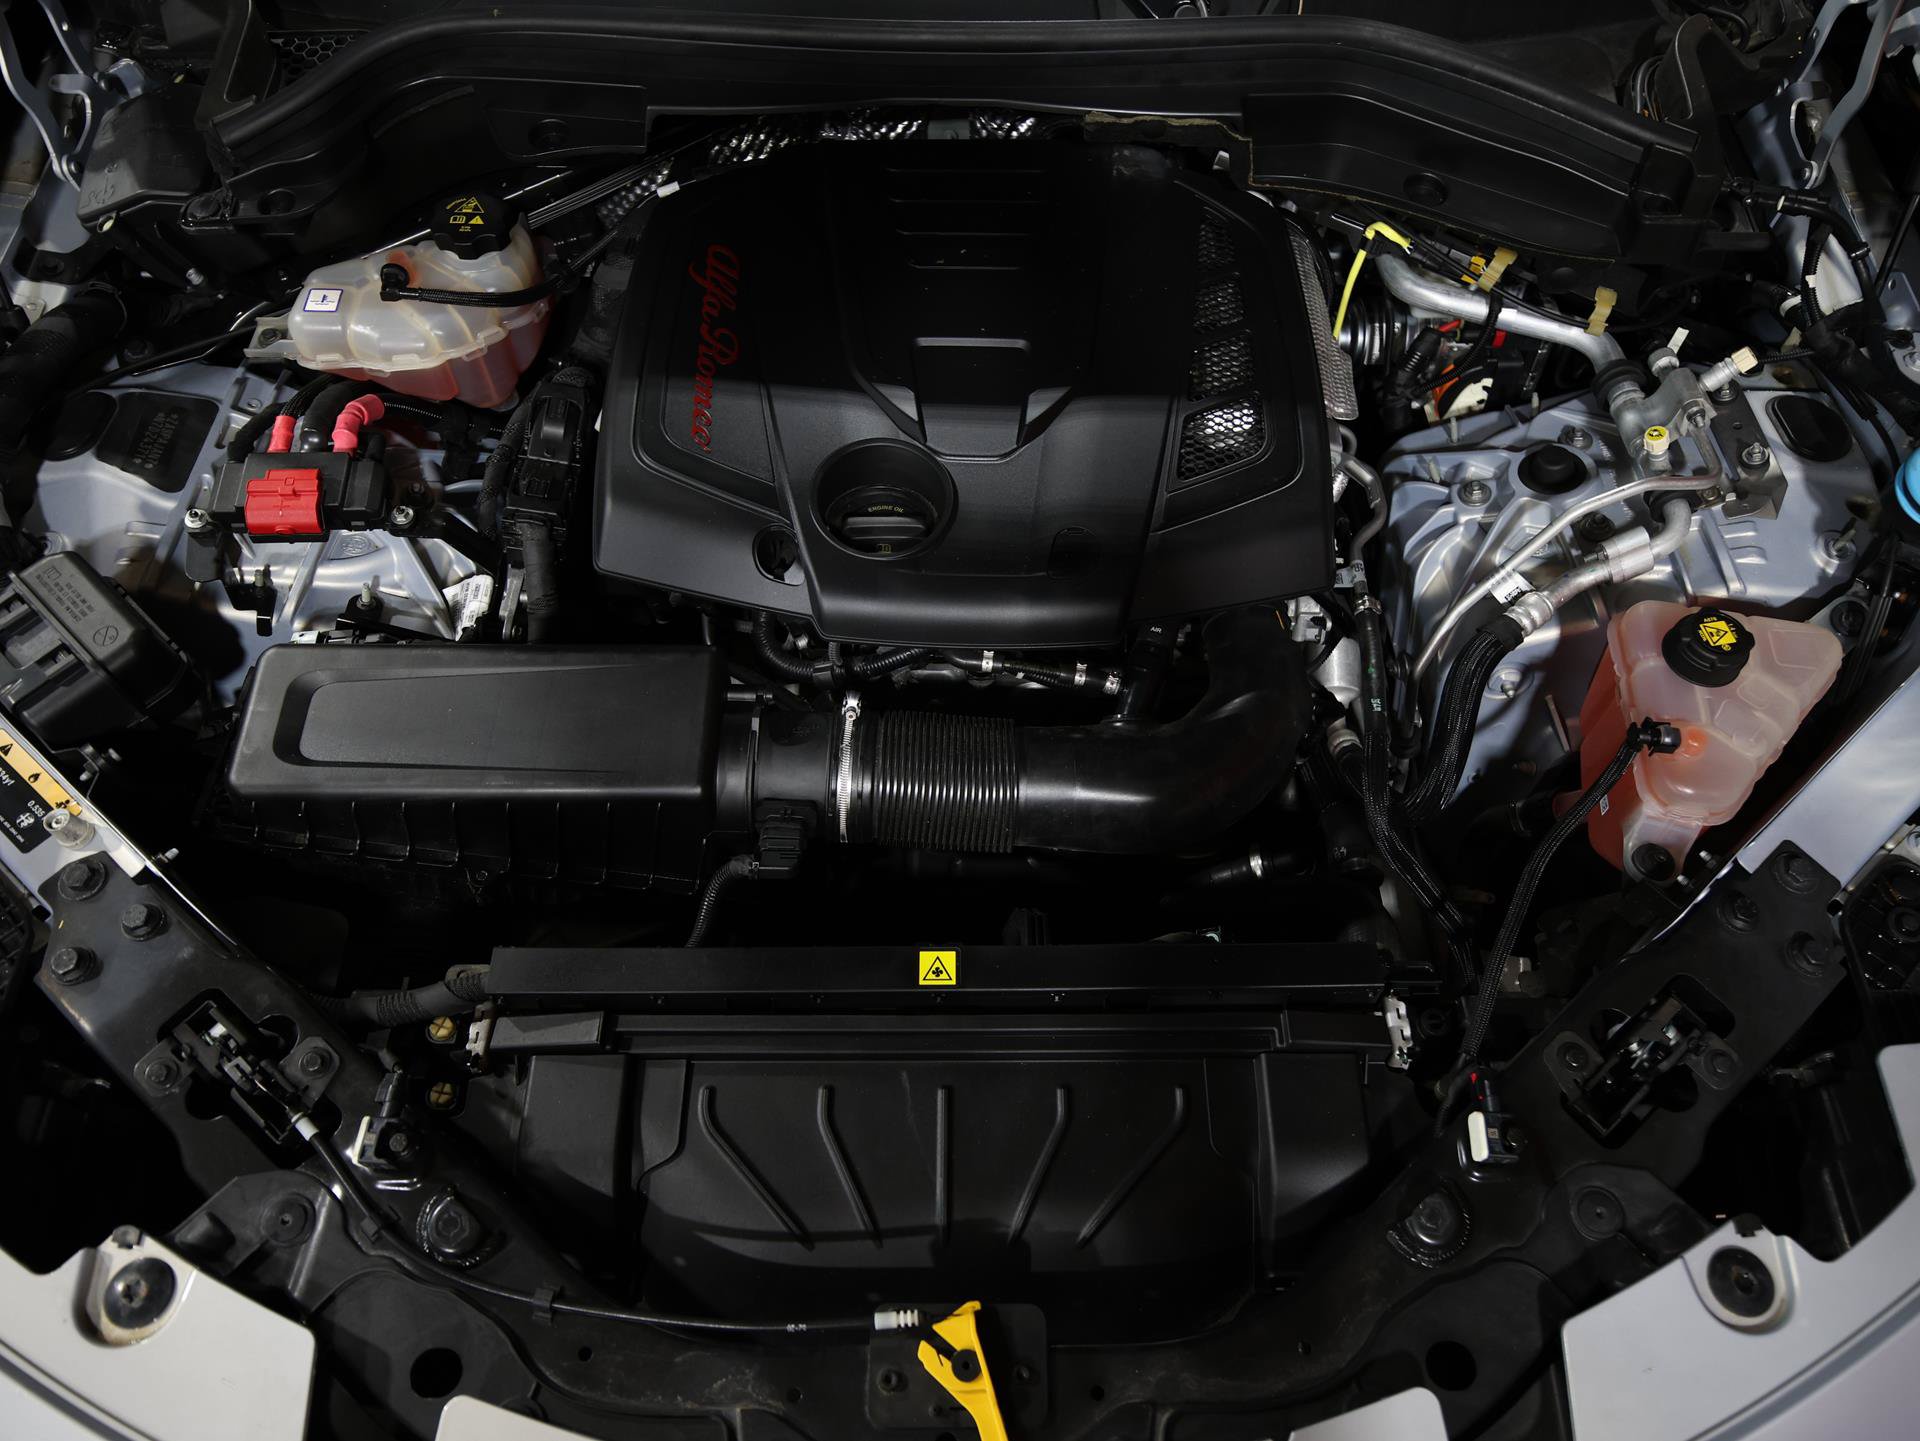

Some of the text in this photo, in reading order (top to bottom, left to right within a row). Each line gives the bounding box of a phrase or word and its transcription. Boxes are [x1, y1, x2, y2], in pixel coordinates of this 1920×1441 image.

[688, 242, 741, 454] Alfa Romeo
[1150, 626, 1162, 634] AIR
[27, 800, 46, 817] 0.535
